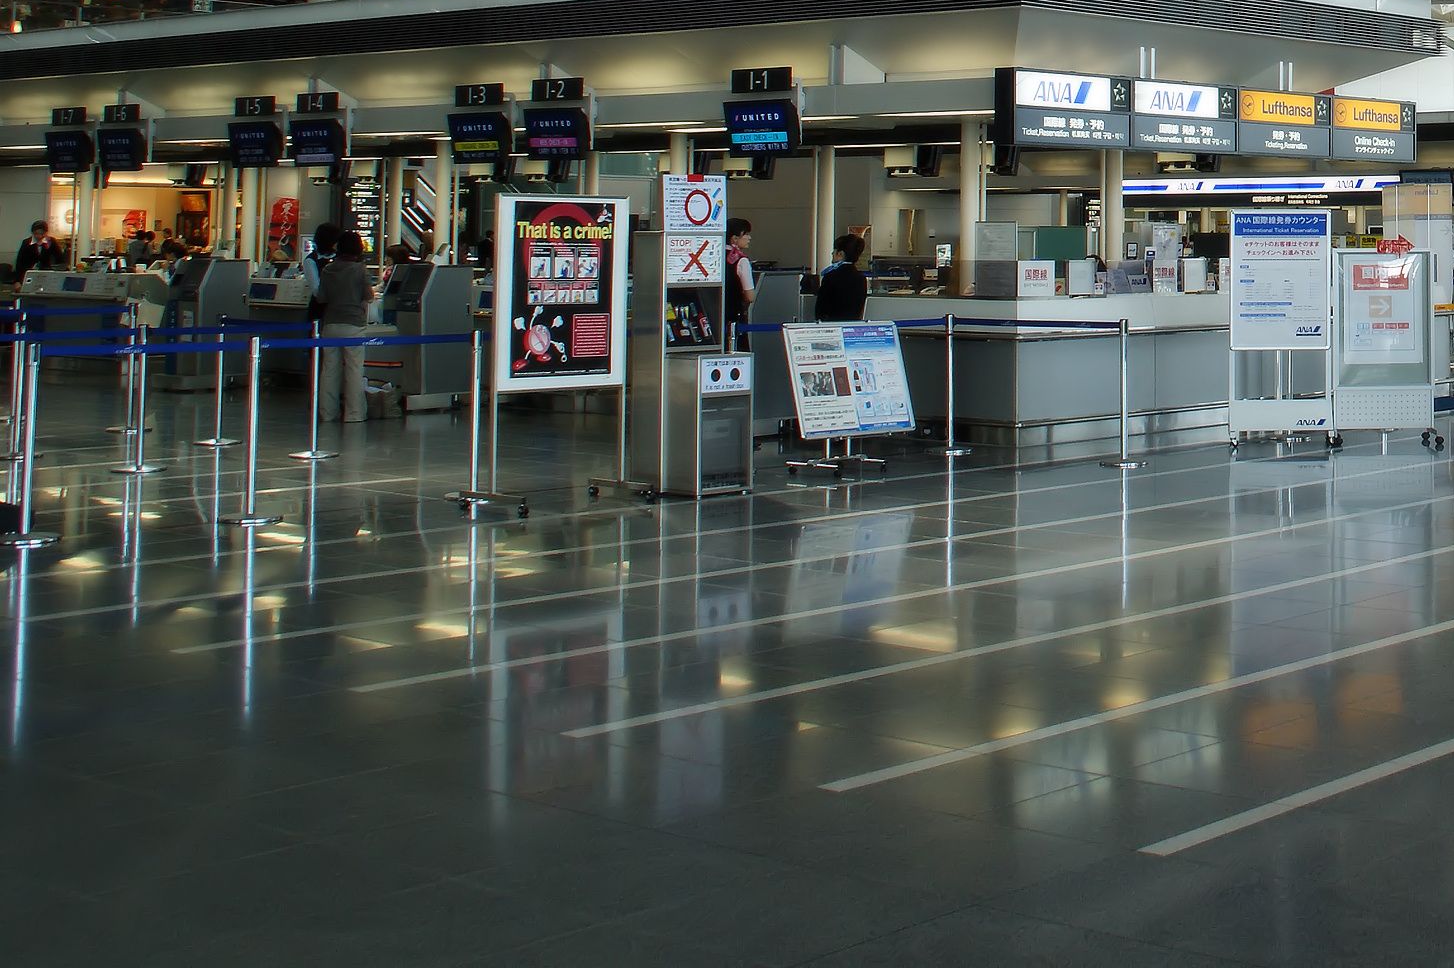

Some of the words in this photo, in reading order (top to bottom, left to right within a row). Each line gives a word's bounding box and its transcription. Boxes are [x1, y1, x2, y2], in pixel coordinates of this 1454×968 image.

[750, 70, 768, 90] I-1
[468, 86, 487, 104] I-3
[545, 80, 565, 99] I-2
[1033, 81, 1072, 104] ANA
[246, 98, 261, 115] I-5
[308, 94, 324, 112] I-4
[1150, 90, 1184, 111] ANA
[1262, 100, 1312, 118] Lufthansa
[539, 120, 572, 128] UNITED
[742, 113, 780, 122] UNITED
[1354, 108, 1398, 124] Lufthansa
[462, 124, 493, 132] UNITED
[1177, 182, 1195, 191] ANA
[1336, 180, 1354, 189] ANA
[1252, 216, 1326, 225] 国際線発券カウンター
[517, 221, 548, 239] That
[550, 222, 561, 239] is
[563, 226, 572, 240] a
[574, 222, 613, 240] crime!
